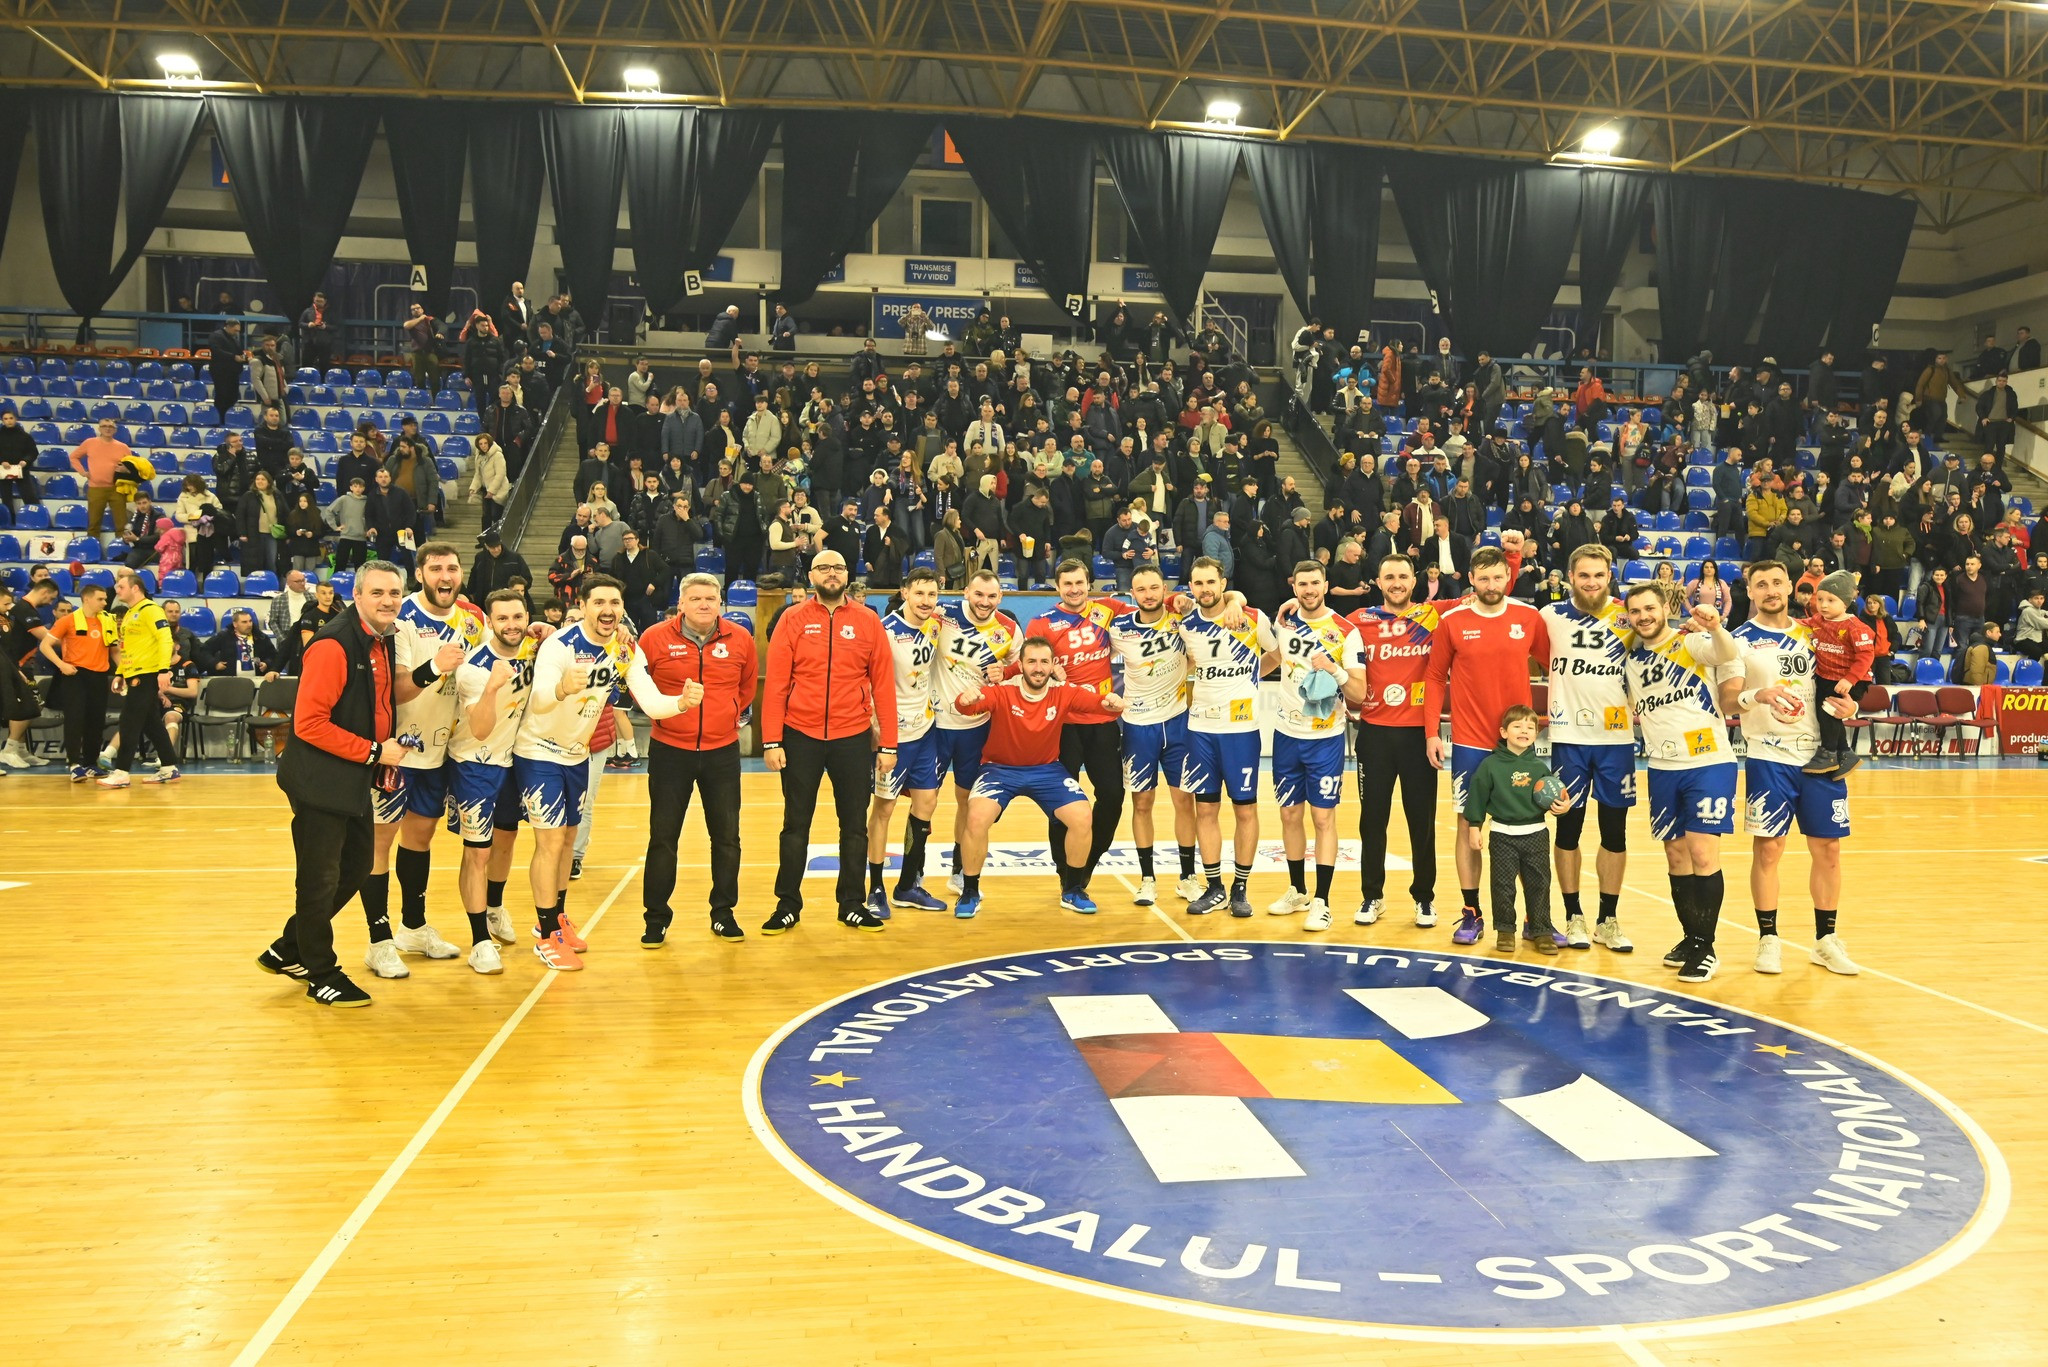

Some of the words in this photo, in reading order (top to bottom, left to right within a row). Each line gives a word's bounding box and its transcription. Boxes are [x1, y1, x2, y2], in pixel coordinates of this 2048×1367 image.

[910, 263, 952, 272] TRANSMISIE
[912, 272, 922, 280] TV
[928, 273, 949, 281] VIDEO
[411, 270, 426, 286] A
[687, 275, 700, 291] B
[935, 306, 976, 319] PRESS
[1068, 298, 1080, 312] B
[1068, 626, 1096, 649] 55
[1378, 621, 1407, 638] 16
[1571, 630, 1604, 649] 13
[912, 646, 931, 666] 20
[951, 638, 982, 659] 17
[1141, 636, 1171, 658] 21
[1208, 638, 1222, 658] 7
[1288, 637, 1315, 658] 97
[1380, 643, 1431, 660] Buzau
[1206, 665, 1253, 680] Buzau
[1552, 657, 1568, 676] CJ
[1572, 659, 1623, 676] Buzau
[1777, 653, 1810, 677] 30
[511, 665, 534, 694] 10
[586, 667, 611, 689] 19
[1640, 663, 1665, 689] 18
[1648, 686, 1695, 712] Buzau
[1609, 722, 1624, 730] TRS
[1694, 744, 1711, 754] TRS
[1241, 767, 1253, 787] 7
[1319, 775, 1340, 796] 97
[1697, 797, 1728, 820] 18
[1046, 948, 1254, 974] SPORT
[1324, 951, 1756, 1037] HANDBALUL
[809, 1097, 1342, 1292] HANDBALUL
[1475, 1212, 1843, 1300] SPORT
